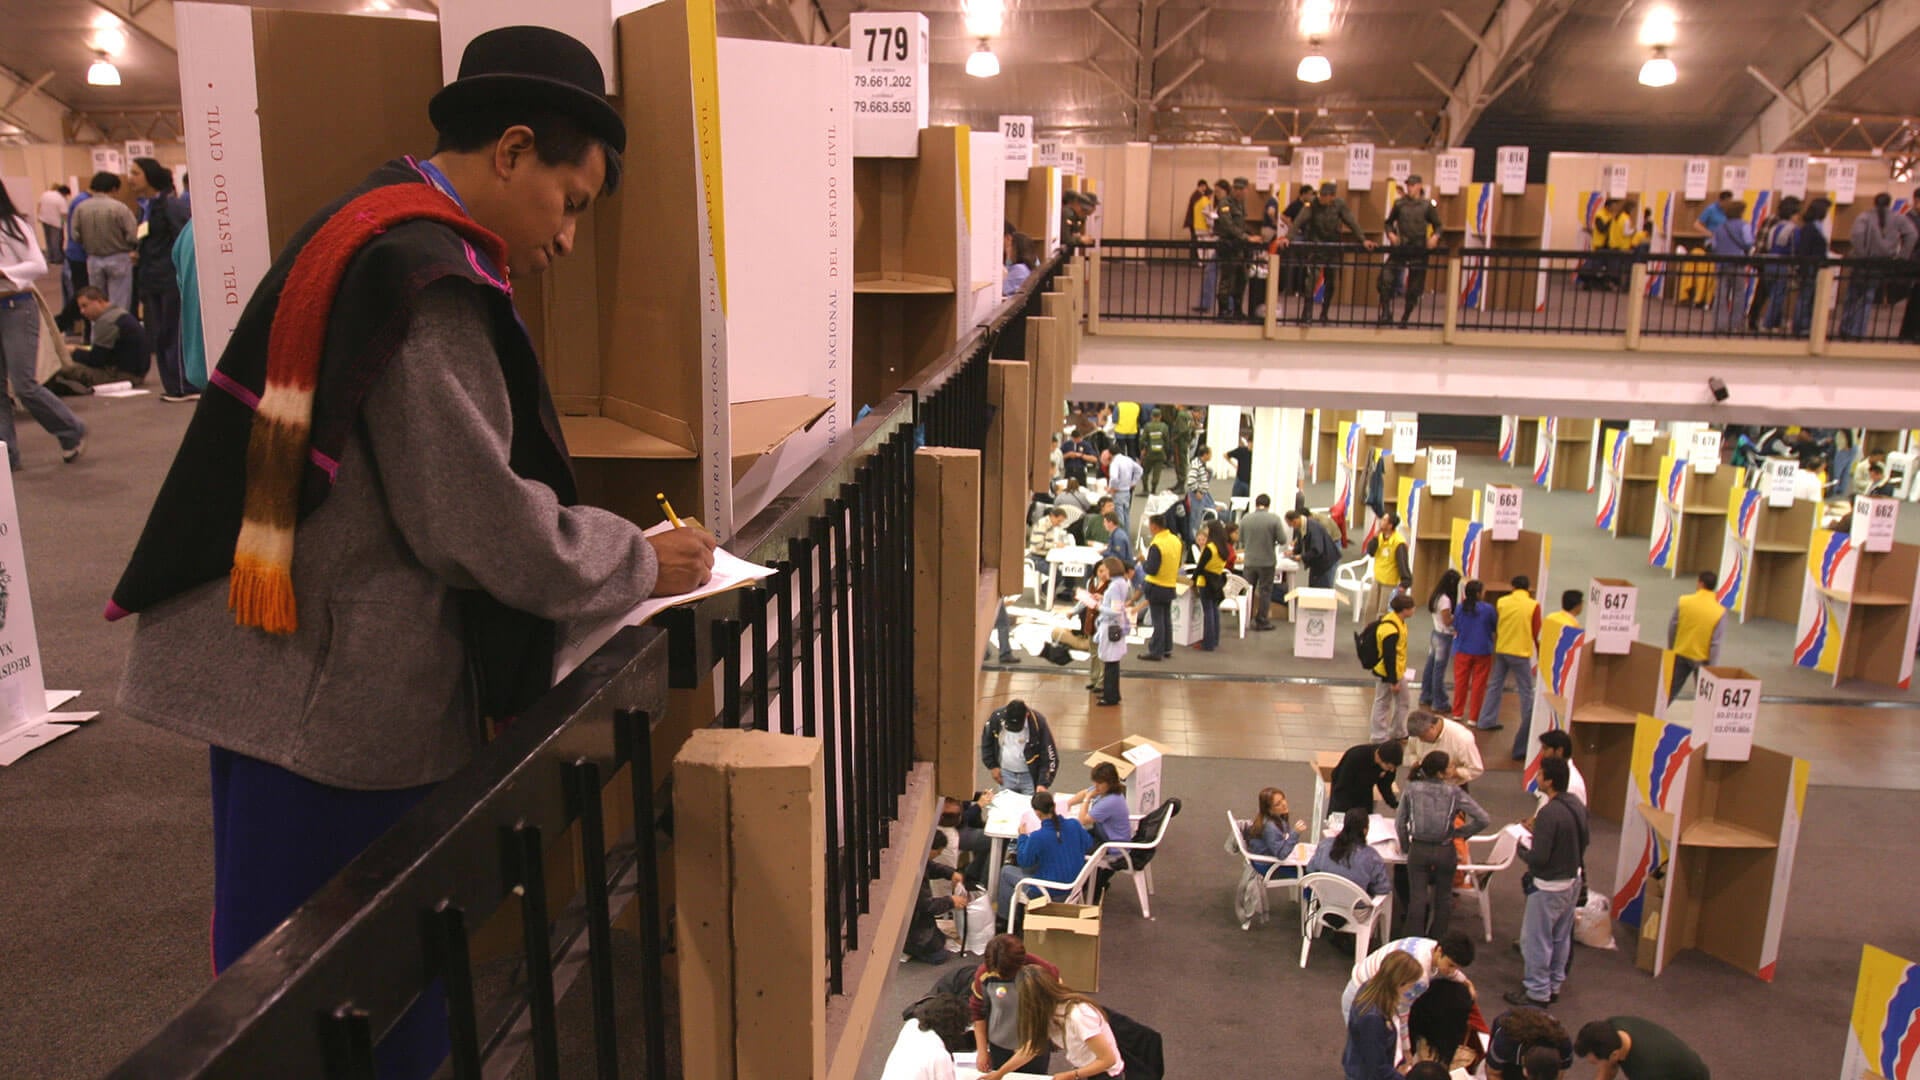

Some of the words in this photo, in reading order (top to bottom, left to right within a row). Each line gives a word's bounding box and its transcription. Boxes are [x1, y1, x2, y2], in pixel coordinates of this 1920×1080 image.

[863, 26, 908, 62] 779
[854, 75, 912, 88] 79.661.202
[853, 101, 911, 113] 79.663.550
[207, 105, 224, 161] CIVIL
[702, 103, 710, 160] CIVIL
[1005, 122, 1025, 138] 780
[828, 124, 837, 168] CIVIL
[213, 173, 233, 254] ESTADO
[705, 174, 714, 257] ESTADO
[829, 176, 838, 238] ESTADO
[829, 247, 838, 277] DEL
[223, 265, 239, 305] DEL
[828, 289, 838, 369] NACIONAL
[711, 328, 719, 436] NACIONAL
[1777, 464, 1795, 477] 662
[1500, 493, 1518, 506] 663
[1875, 503, 1895, 518] 662
[1604, 593, 1629, 610] 647
[0, 655, 31, 680] REGIS
[1699, 677, 1714, 701] 647
[1722, 687, 1752, 708] 647
